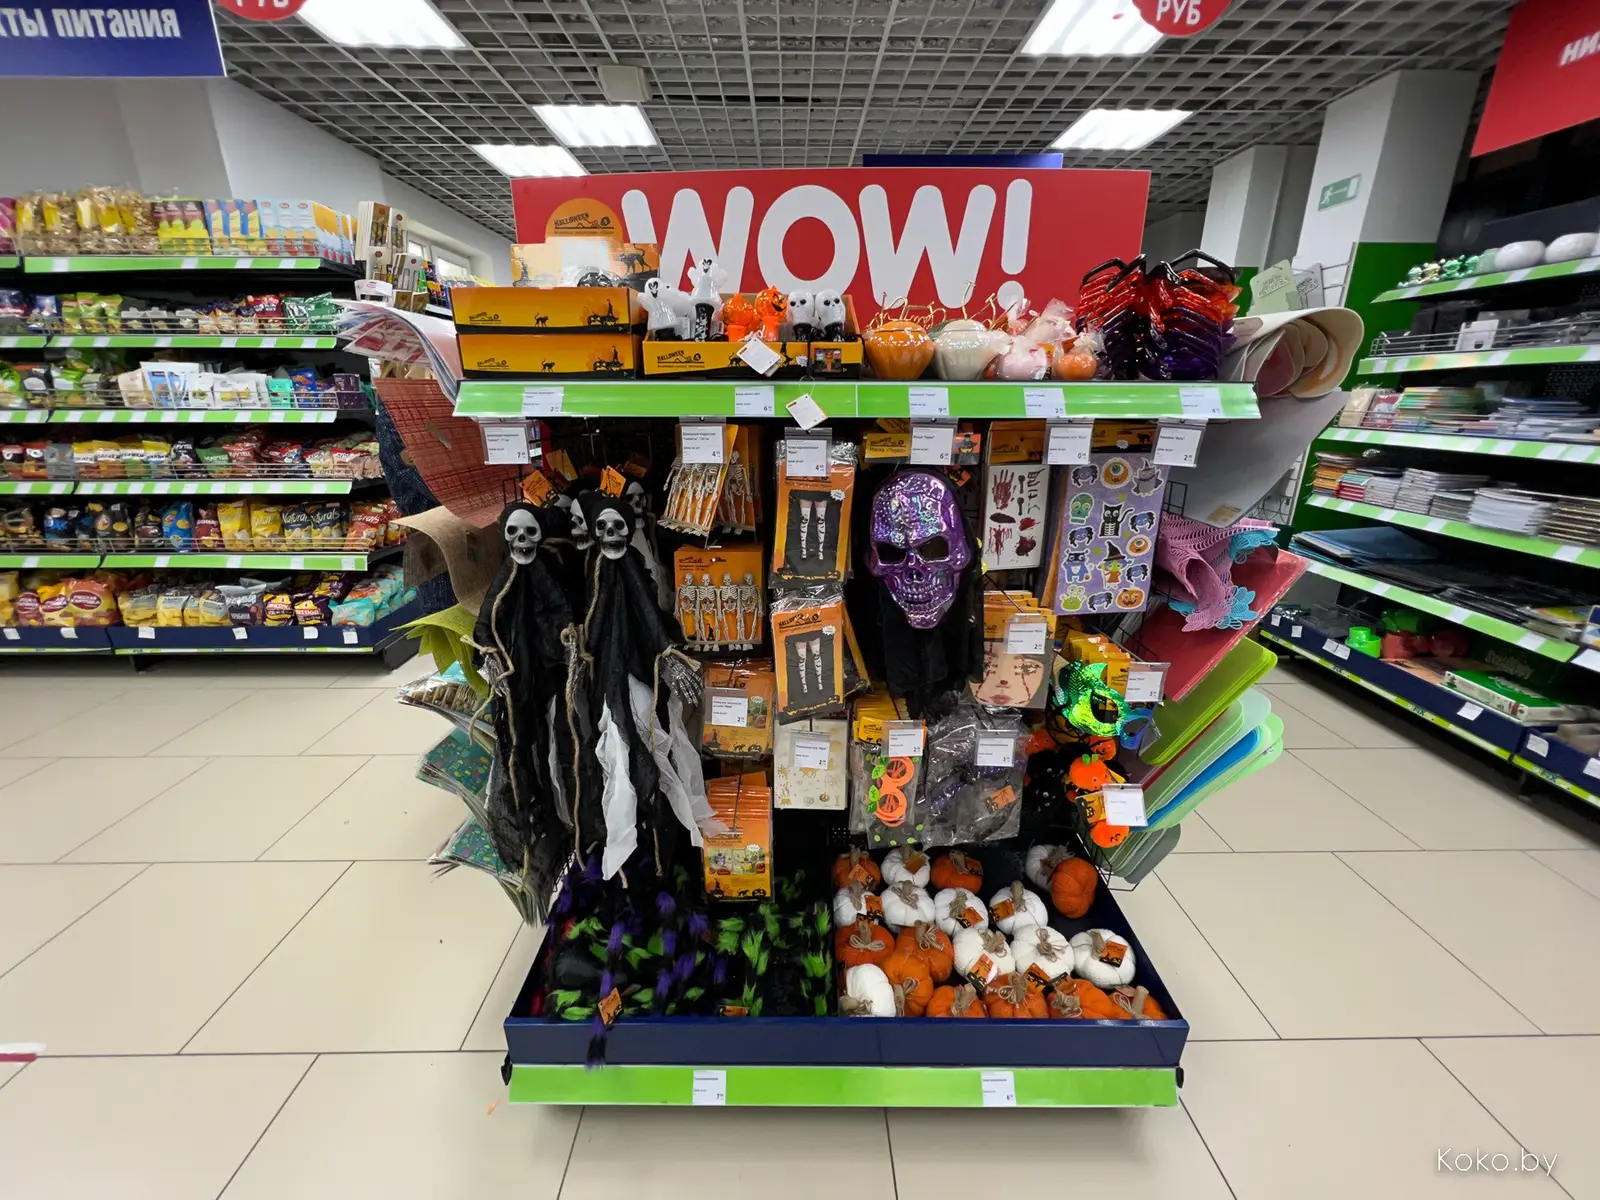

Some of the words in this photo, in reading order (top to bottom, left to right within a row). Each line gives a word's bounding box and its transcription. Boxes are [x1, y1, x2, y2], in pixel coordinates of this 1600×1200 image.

[1156, 0, 1201, 25] РУБ
[554, 212, 589, 227] HALLOWEEN
[621, 178, 1033, 310] WOW!
[657, 349, 685, 362] HALLOWEEN
